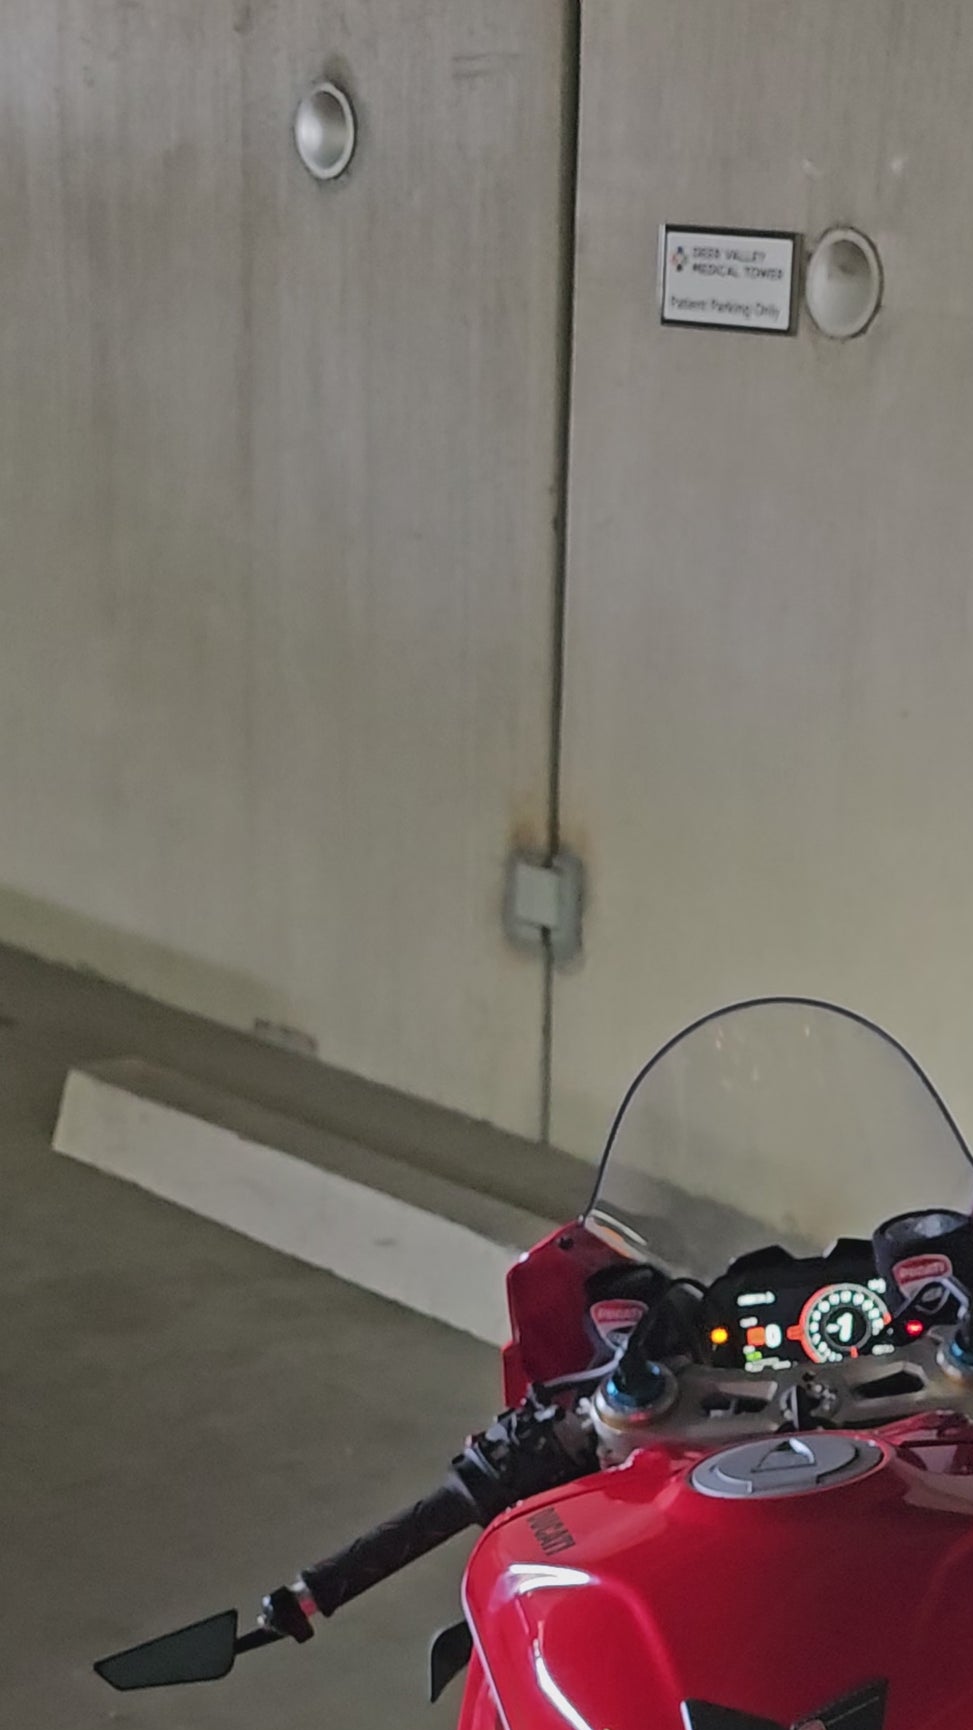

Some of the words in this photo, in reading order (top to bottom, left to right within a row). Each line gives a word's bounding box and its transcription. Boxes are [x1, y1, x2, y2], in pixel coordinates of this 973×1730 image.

[725, 251, 766, 263] VALLEY
[692, 264, 739, 278] MEDICAL
[744, 268, 784, 281] TOWER
[671, 295, 706, 310] Patient
[711, 299, 750, 318] Parking
[755, 302, 780, 321] Only
[527, 1506, 576, 1556] DUCATI
